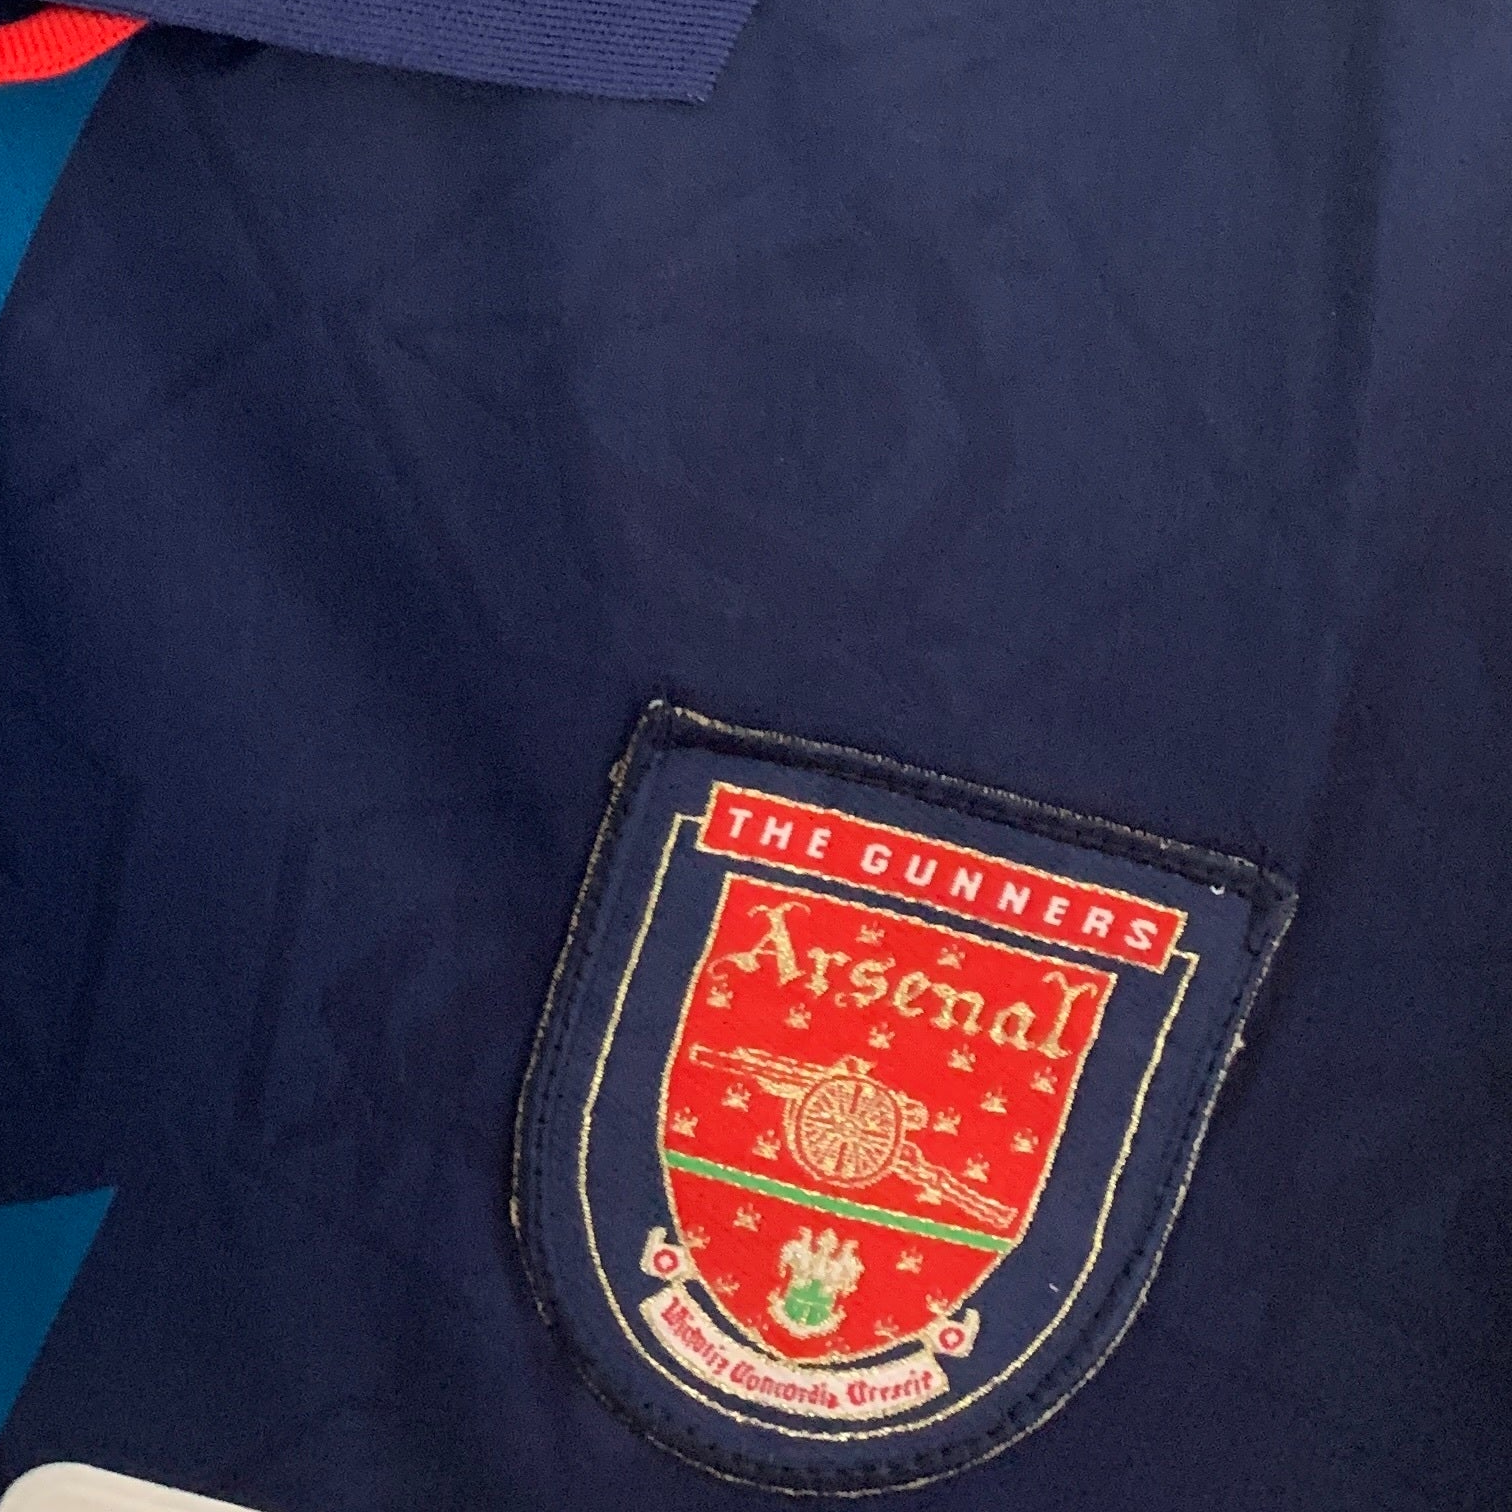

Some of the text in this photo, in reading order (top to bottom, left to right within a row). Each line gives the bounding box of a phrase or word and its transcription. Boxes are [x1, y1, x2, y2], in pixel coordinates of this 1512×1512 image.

[727, 806, 1158, 951] THE GUNNERS
[707, 901, 1097, 1059] Arsenal
